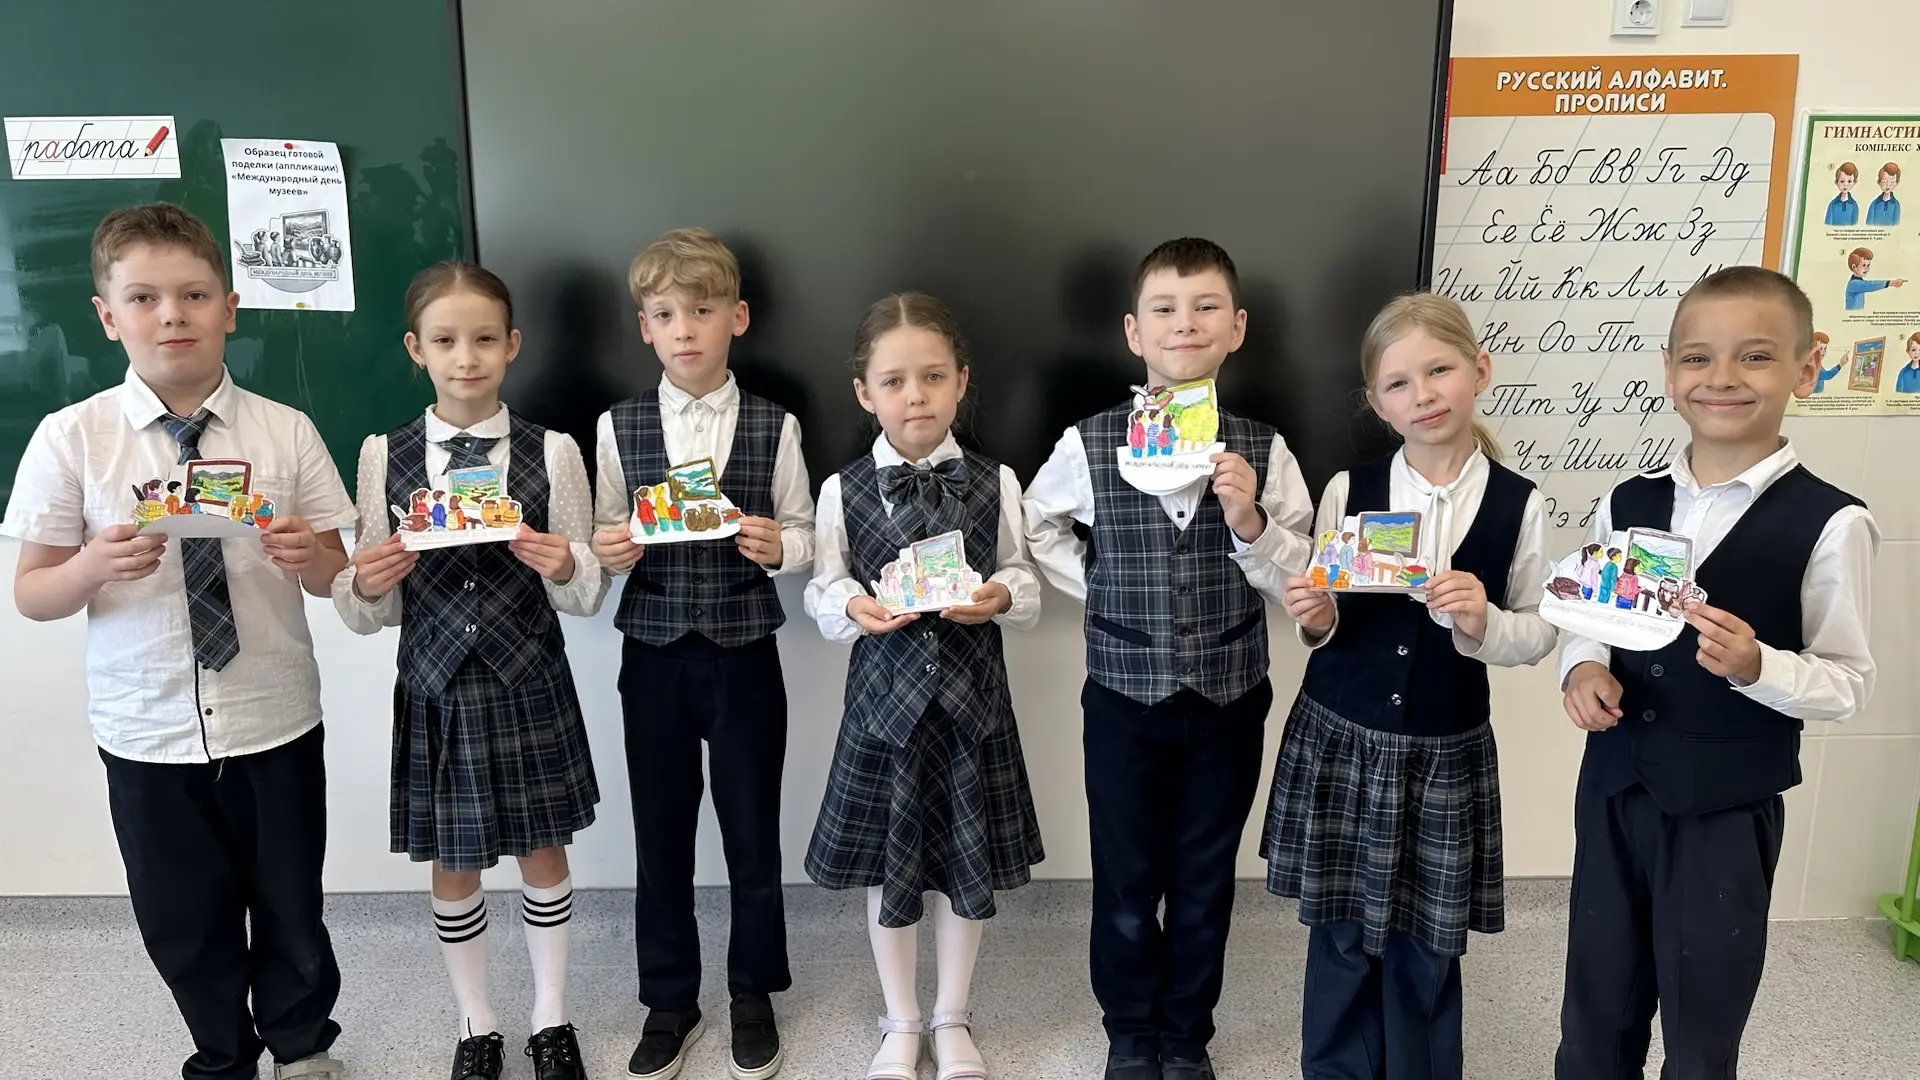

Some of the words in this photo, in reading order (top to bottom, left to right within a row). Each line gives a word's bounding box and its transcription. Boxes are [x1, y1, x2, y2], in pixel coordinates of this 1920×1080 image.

[1496, 66, 1602, 91] РУССКИЙ
[1607, 68, 1728, 91] АЛФАВИТ.
[1554, 92, 1666, 113] ПРОПИСИ
[18, 122, 140, 176] работа
[244, 147, 287, 158] Образец
[288, 150, 324, 159] готовой
[1854, 143, 1912, 152] КОМПЛЕКС
[231, 161, 274, 169] поделки
[275, 161, 339, 173] (аппликации)
[231, 172, 319, 184] «Международный
[320, 177, 342, 185] день
[1458, 149, 1519, 186] Аа
[1529, 148, 1596, 185] Бб
[1588, 147, 1642, 184] Вв
[1646, 147, 1688, 183] Гг
[1699, 146, 1750, 198] Дд
[268, 187, 309, 196] музеев»
[1482, 208, 1518, 244] Ее
[1530, 204, 1566, 243] Ёё
[1579, 207, 1668, 242] Жж
[1677, 206, 1717, 257] Зз
[1435, 267, 1483, 302] Ии
[1494, 259, 1543, 301] Йй
[1551, 265, 1600, 299] Кк
[1607, 265, 1669, 298] Лл
[1478, 321, 1525, 353] Нн
[1538, 320, 1575, 352] Оо
[1588, 320, 1645, 352] Пп
[1482, 383, 1555, 416] Тт
[1566, 381, 1603, 428] Уу
[1613, 380, 1665, 427] Фф
[1513, 440, 1552, 471] Чч
[1563, 438, 1628, 470] Шш
